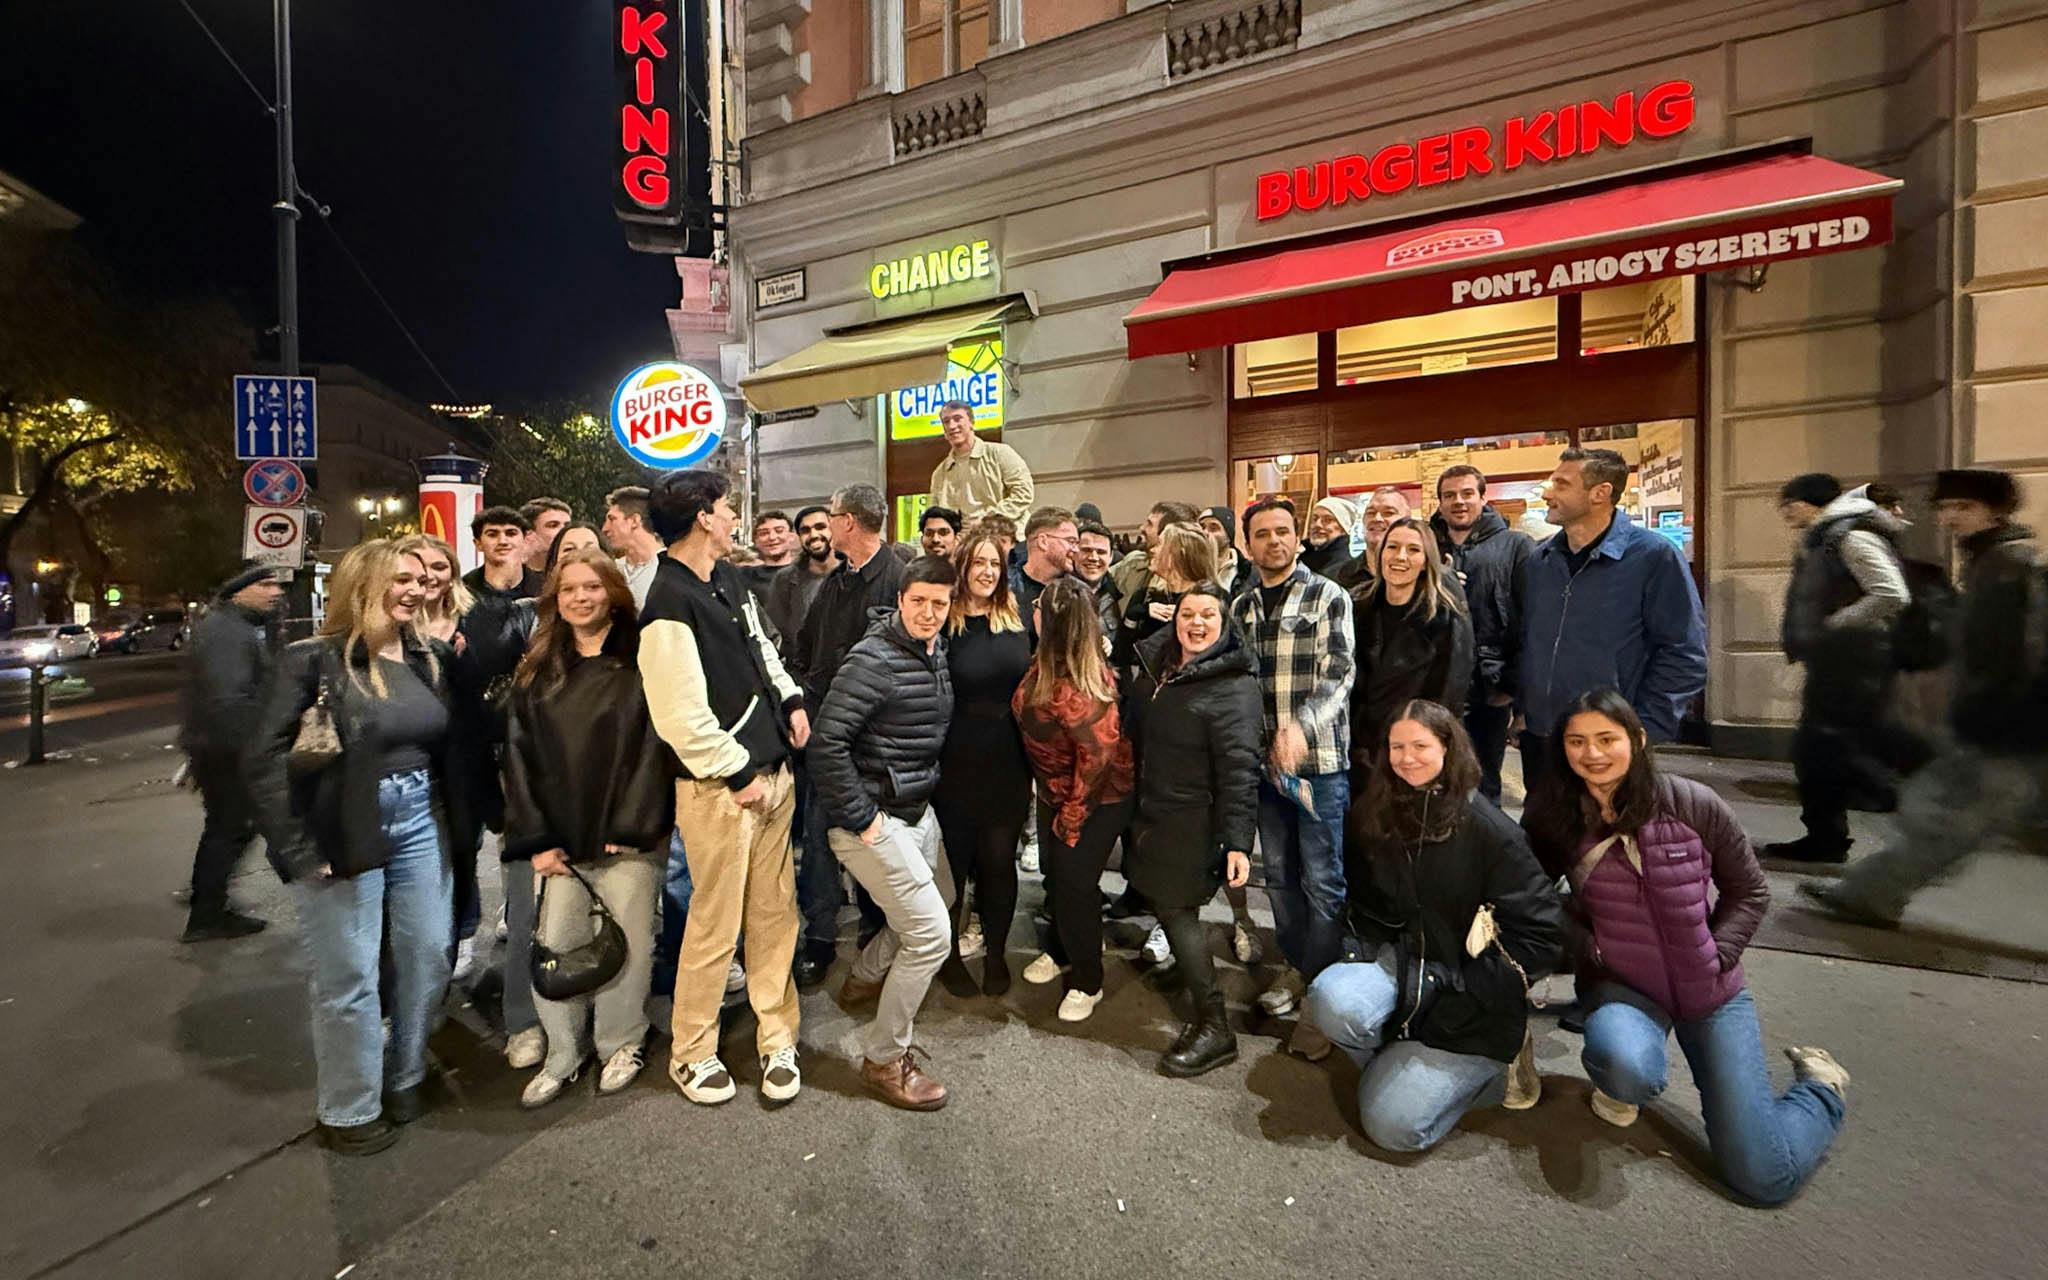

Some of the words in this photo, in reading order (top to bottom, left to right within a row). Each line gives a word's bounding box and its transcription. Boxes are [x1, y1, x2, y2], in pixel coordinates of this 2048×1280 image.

[622, 6, 669, 206] KING
[1257, 126, 1495, 220] BURGER
[1504, 80, 1695, 169] KING
[870, 240, 991, 299] CHANGE
[1452, 269, 1543, 304] PONT,
[1547, 246, 1671, 289] AHOGY
[1675, 216, 1870, 269] SZERETED
[624, 383, 709, 418] BURGER
[630, 401, 712, 445] KING
[899, 373, 998, 418] CHANGE
